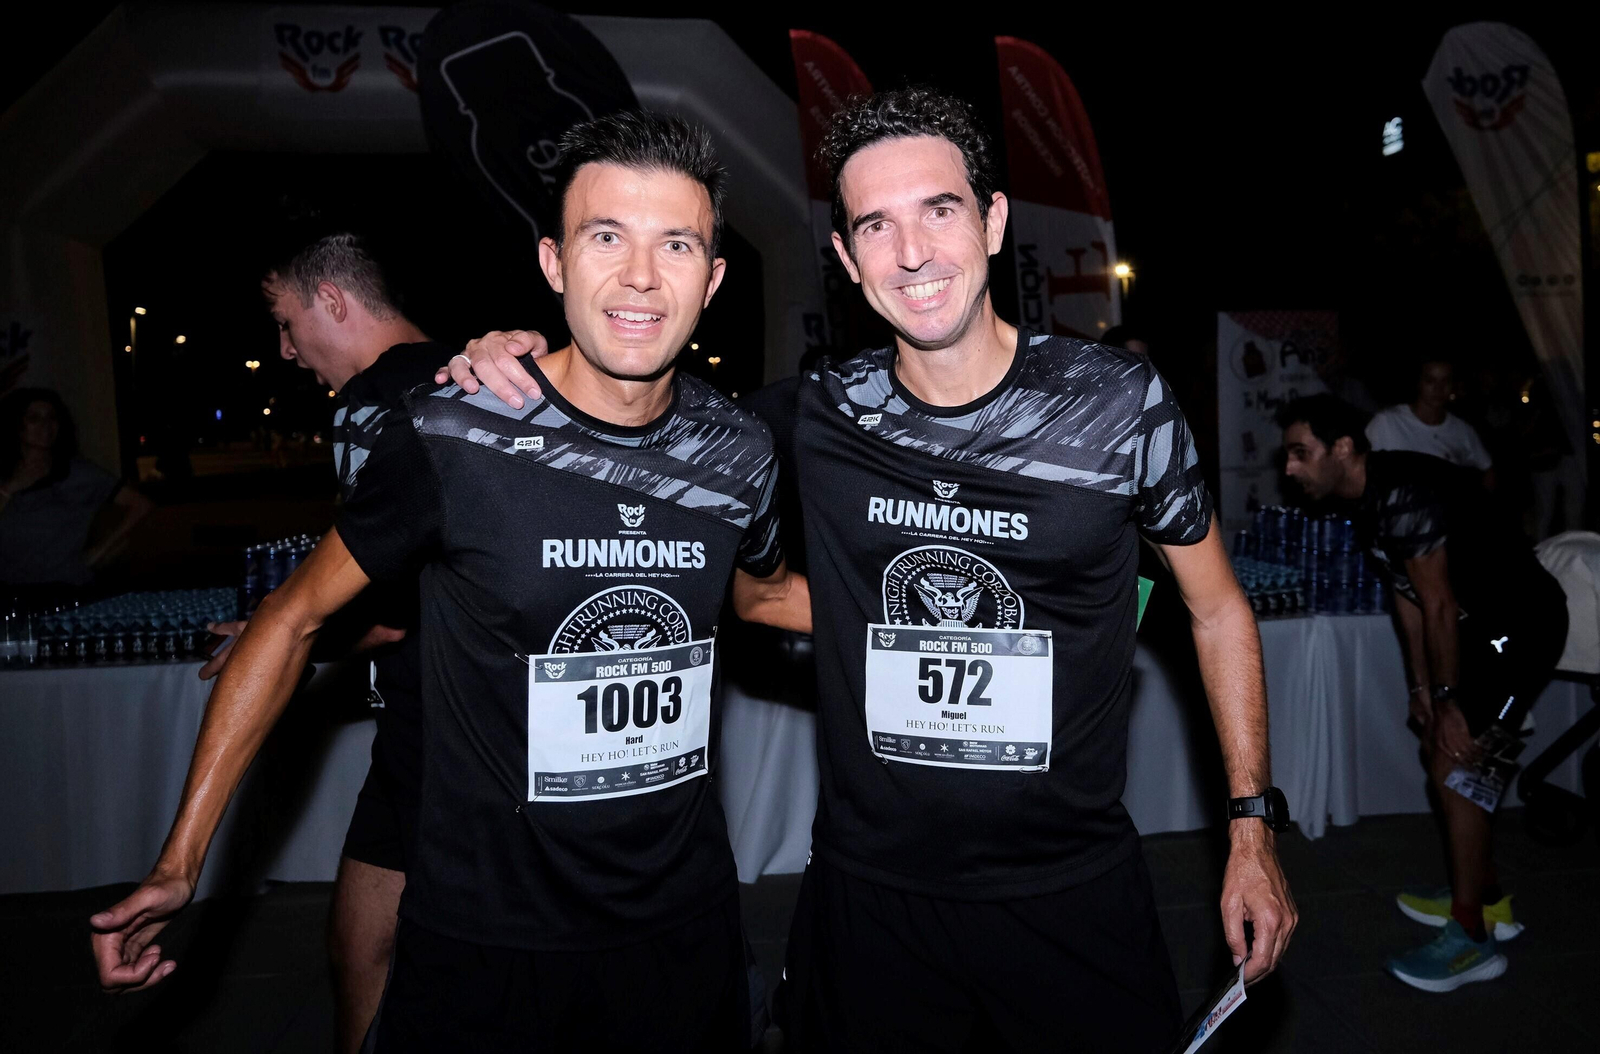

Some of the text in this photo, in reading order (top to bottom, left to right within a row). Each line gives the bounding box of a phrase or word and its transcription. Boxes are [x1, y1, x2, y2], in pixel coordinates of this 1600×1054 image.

[274, 24, 363, 62] Rock
[379, 26, 423, 63] Ro
[516, 438, 541, 447] 42K
[932, 480, 961, 491] Rock
[617, 503, 646, 518] Rock
[867, 496, 1029, 541] RUNMONES
[919, 532, 948, 540] CARRERA
[542, 539, 706, 569] RUNMONES
[887, 550, 972, 616] NIGHTRUNNING
[554, 591, 687, 655] GHTRUNNING CÓRD
[919, 640, 993, 654] ROCK FM 500
[543, 661, 567, 673] Rock
[617, 656, 653, 664] CATEGORÍA
[595, 660, 672, 678] ROCK FM 500
[918, 657, 994, 706] 572
[577, 675, 682, 734] 1003
[941, 710, 967, 720] Miguel
[906, 719, 1005, 734] HEY HO! LET'S RUN
[625, 734, 644, 745] Hard
[581, 740, 679, 763] HEY HO! LET'S RUN
[544, 775, 568, 784] Smilke
